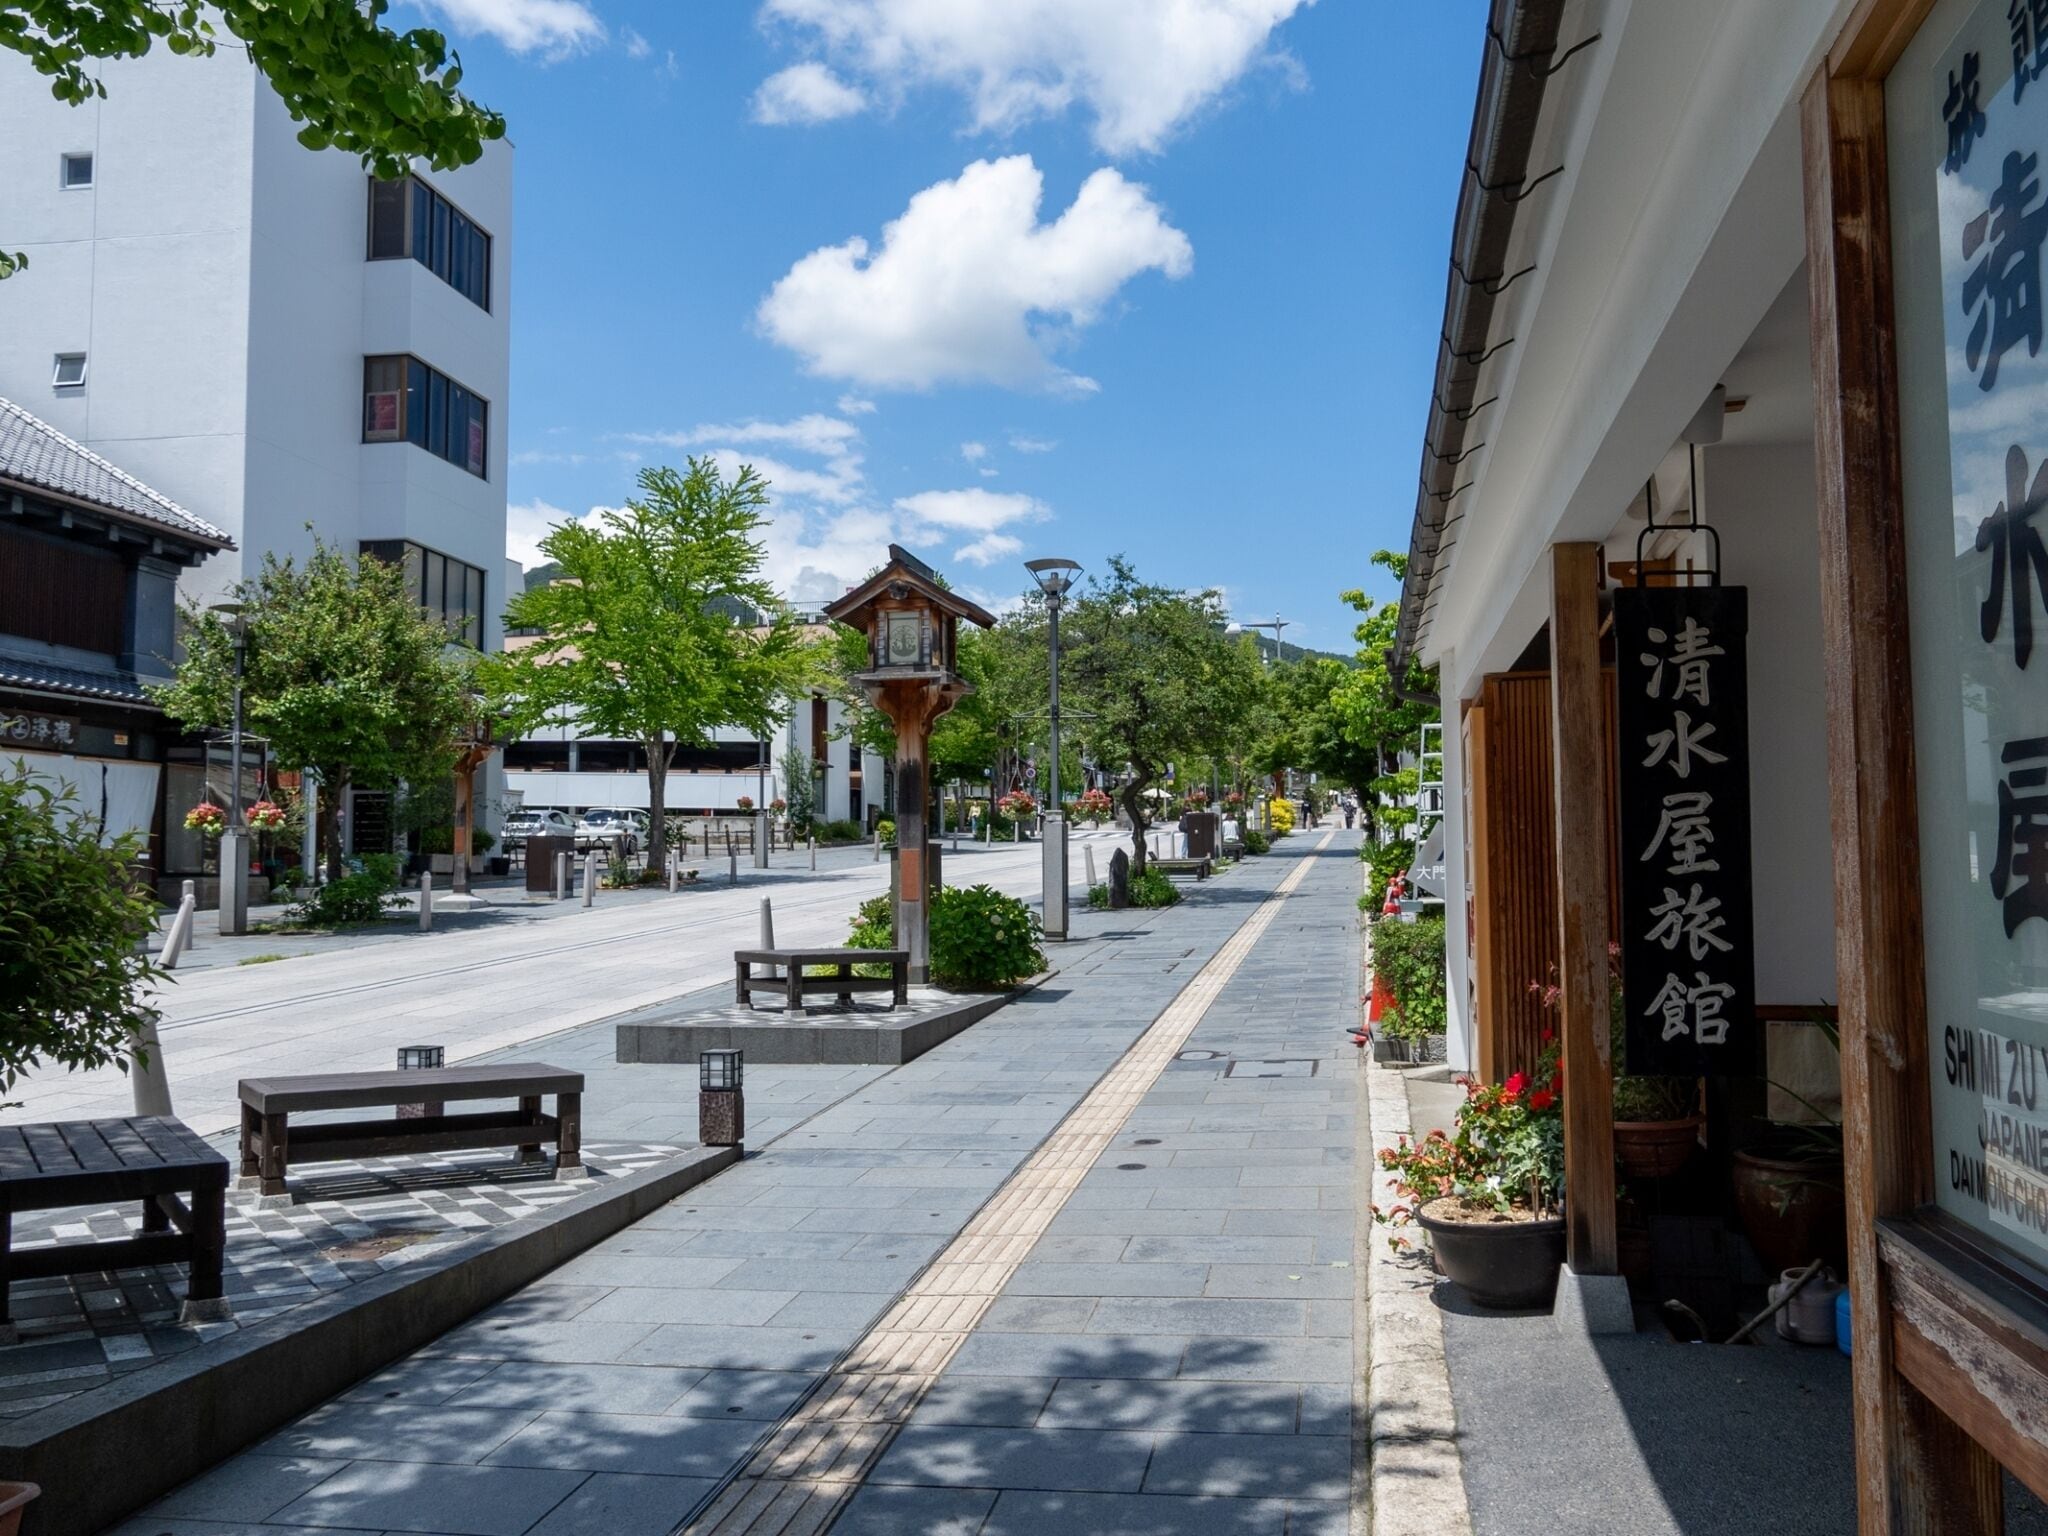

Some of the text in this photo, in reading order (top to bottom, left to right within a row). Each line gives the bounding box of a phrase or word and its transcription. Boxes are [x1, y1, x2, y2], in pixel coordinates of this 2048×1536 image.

[1640, 617, 1736, 1046] 清水屋旅館
